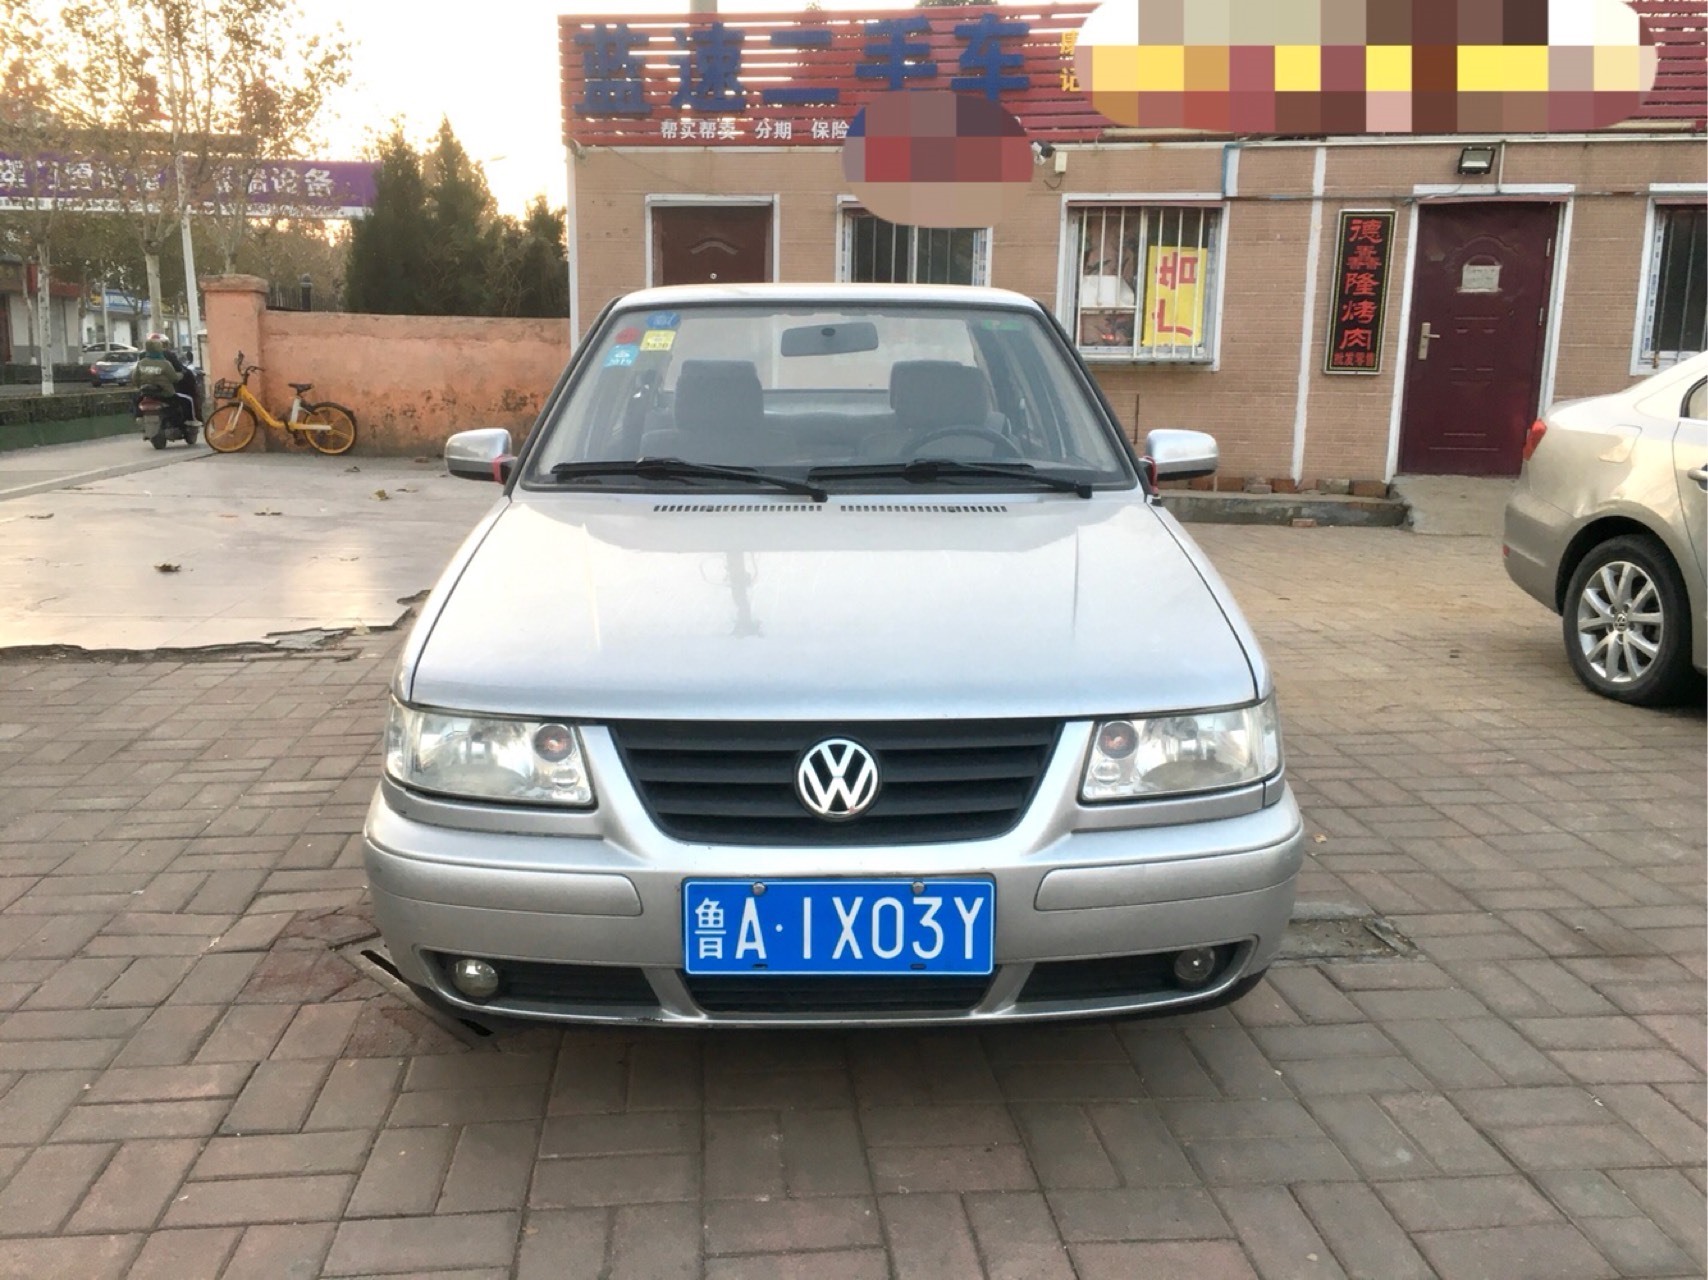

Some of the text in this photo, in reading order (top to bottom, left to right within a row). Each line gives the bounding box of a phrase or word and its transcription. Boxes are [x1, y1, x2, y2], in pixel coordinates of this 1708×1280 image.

[574, 13, 1030, 116] 蓝速二手车
[755, 120, 792, 139] 分期
[811, 120, 849, 139] 保险
[1152, 251, 1198, 337] 广告
